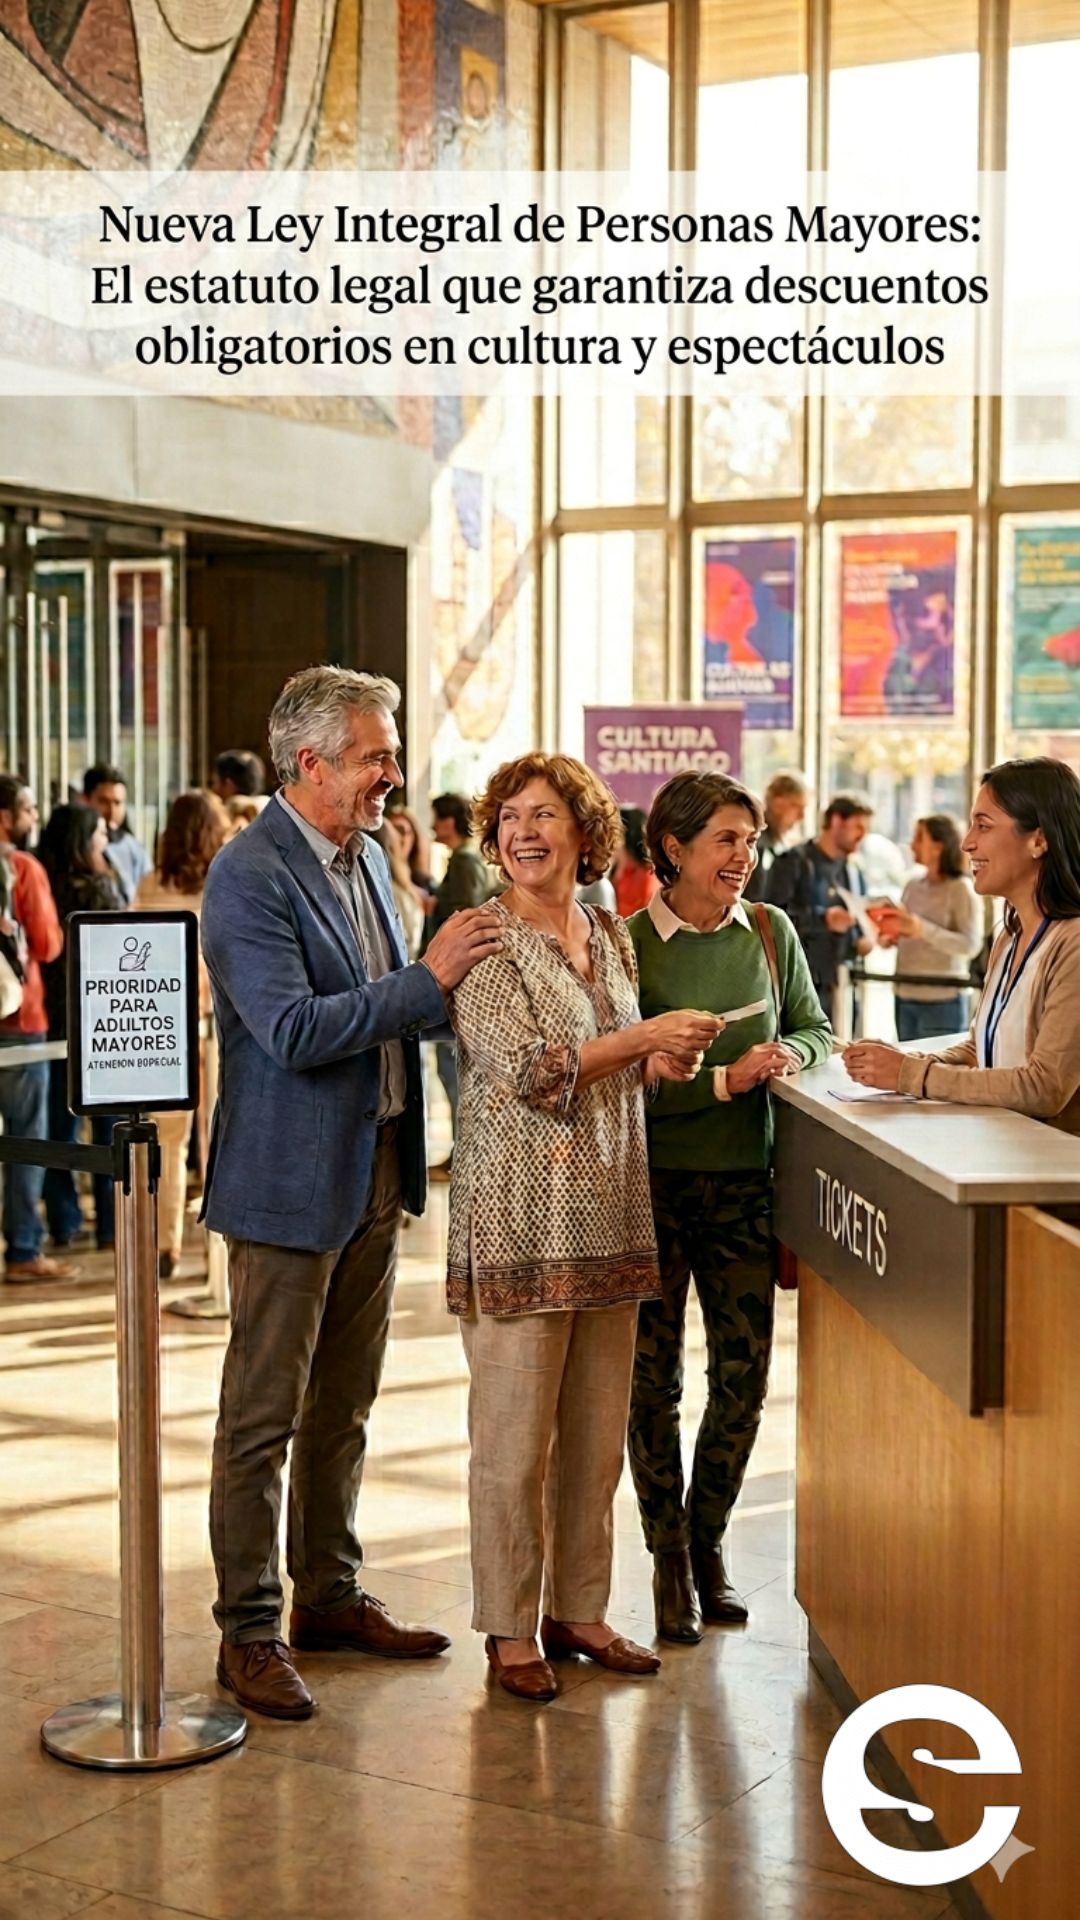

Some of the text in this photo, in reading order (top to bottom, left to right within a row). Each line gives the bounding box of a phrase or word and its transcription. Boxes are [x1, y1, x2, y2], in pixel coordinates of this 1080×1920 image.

[597, 725, 718, 749] CULTURA
[597, 750, 731, 774] SANTIAGO
[85, 978, 181, 995] PRIORIDAD
[109, 998, 158, 1013] PARA
[92, 1035, 177, 1053] MAYORES
[815, 1167, 888, 1277] TICKETS
